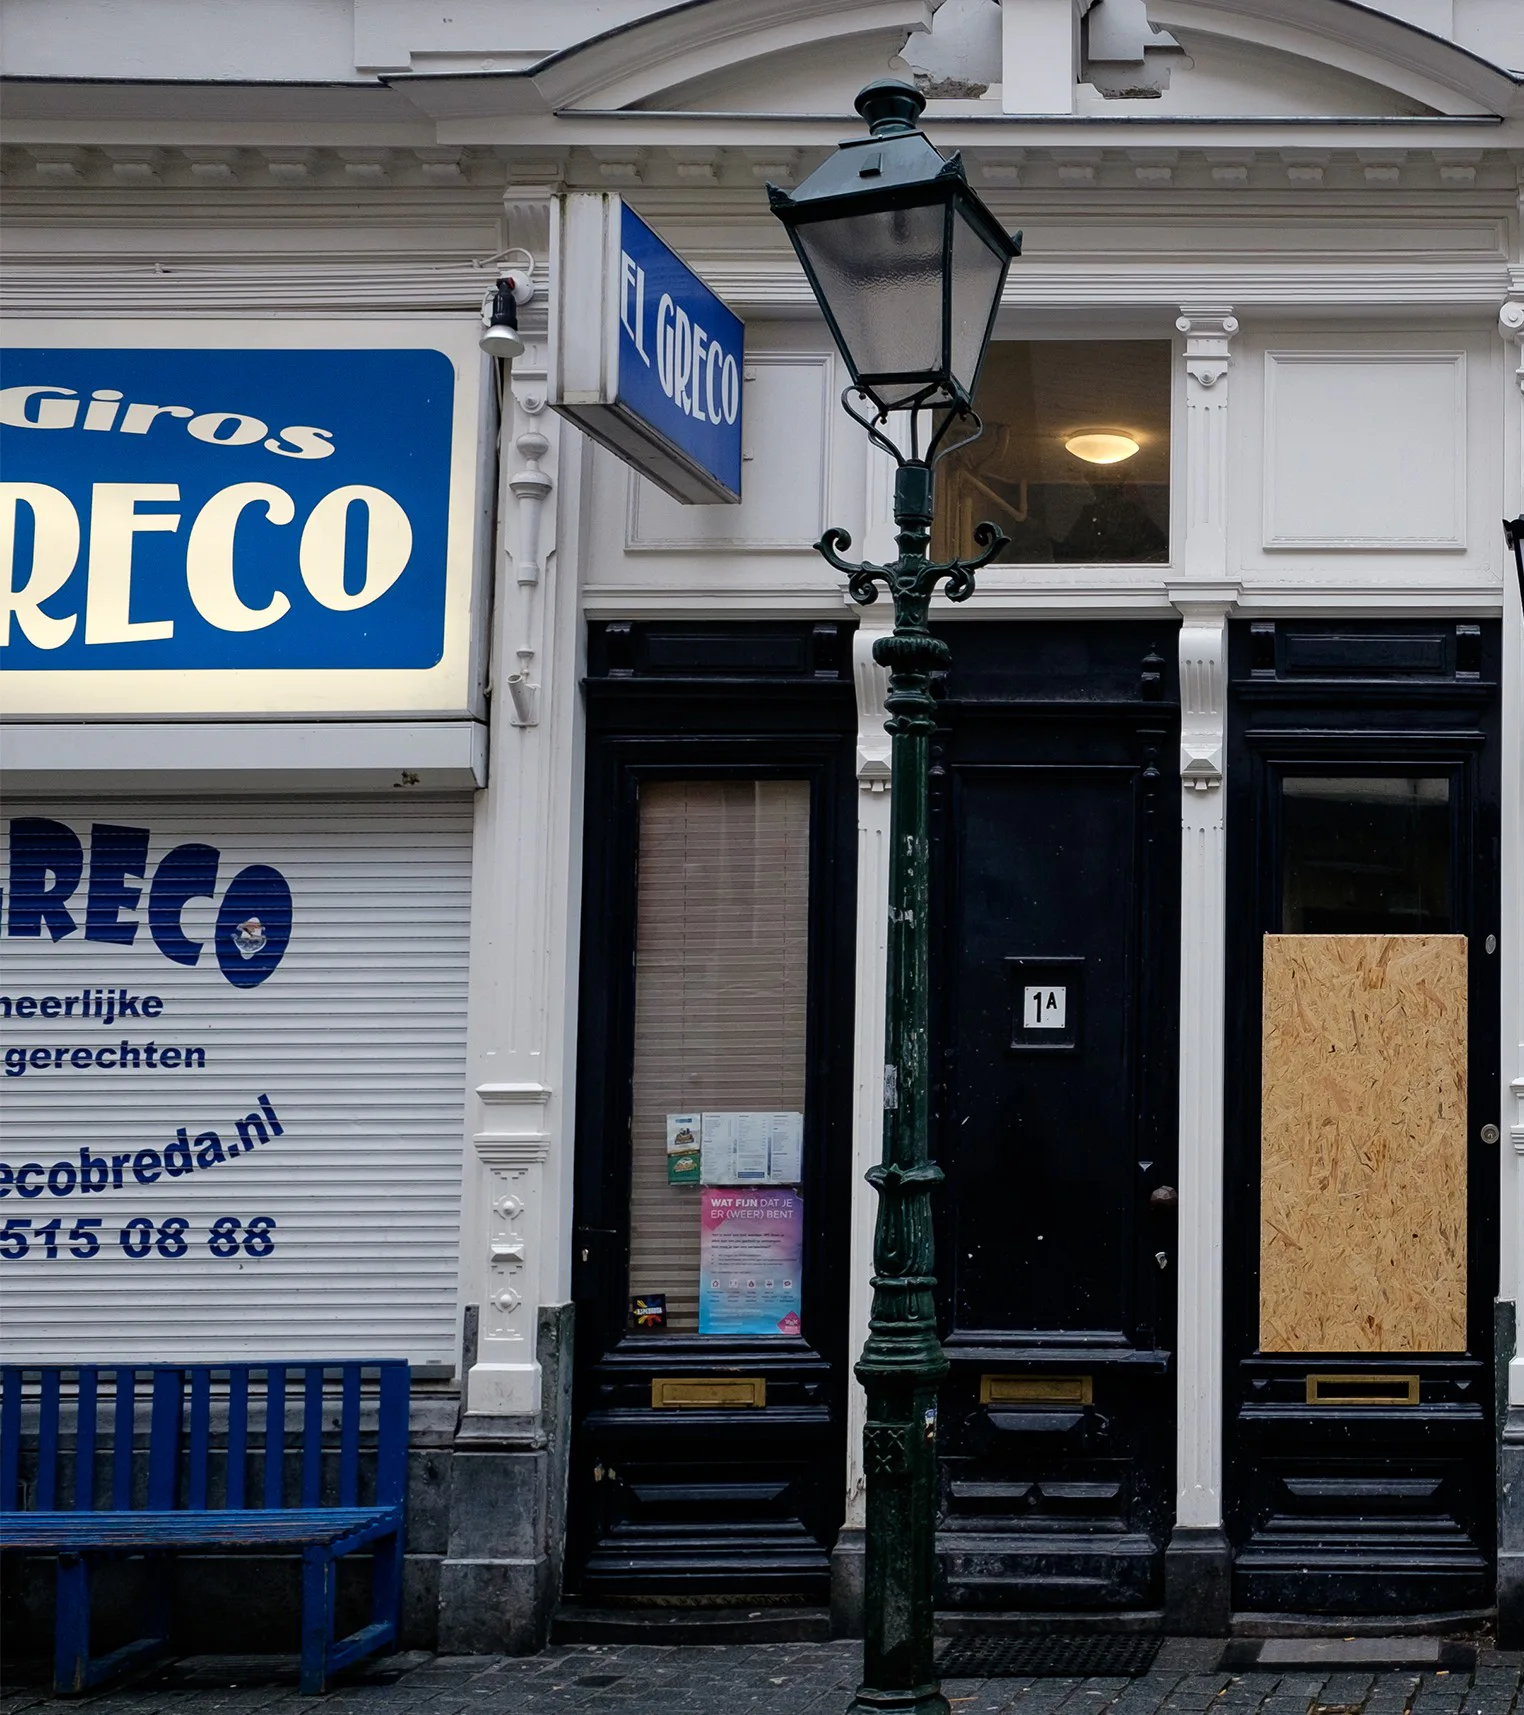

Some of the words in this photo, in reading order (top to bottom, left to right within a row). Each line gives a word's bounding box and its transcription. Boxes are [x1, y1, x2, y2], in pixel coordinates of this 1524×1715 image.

[621, 249, 650, 368] EL
[656, 293, 739, 425] GRECO
[0, 386, 336, 459] Giros
[0, 817, 293, 989] RECO
[1033, 991, 1058, 1023] 1A
[5, 1041, 206, 1076] gerechten
[711, 1198, 735, 1208] WAT
[735, 1198, 758, 1208] FIJN
[760, 1198, 779, 1208] DAT
[781, 1198, 793, 1208] JE
[711, 1210, 724, 1219] ER
[726, 1209, 764, 1220] (WEER)
[766, 1209, 794, 1219] BENT
[0, 1218, 102, 1259] 515
[119, 1218, 190, 1259] 08
[207, 1216, 277, 1259] 88
